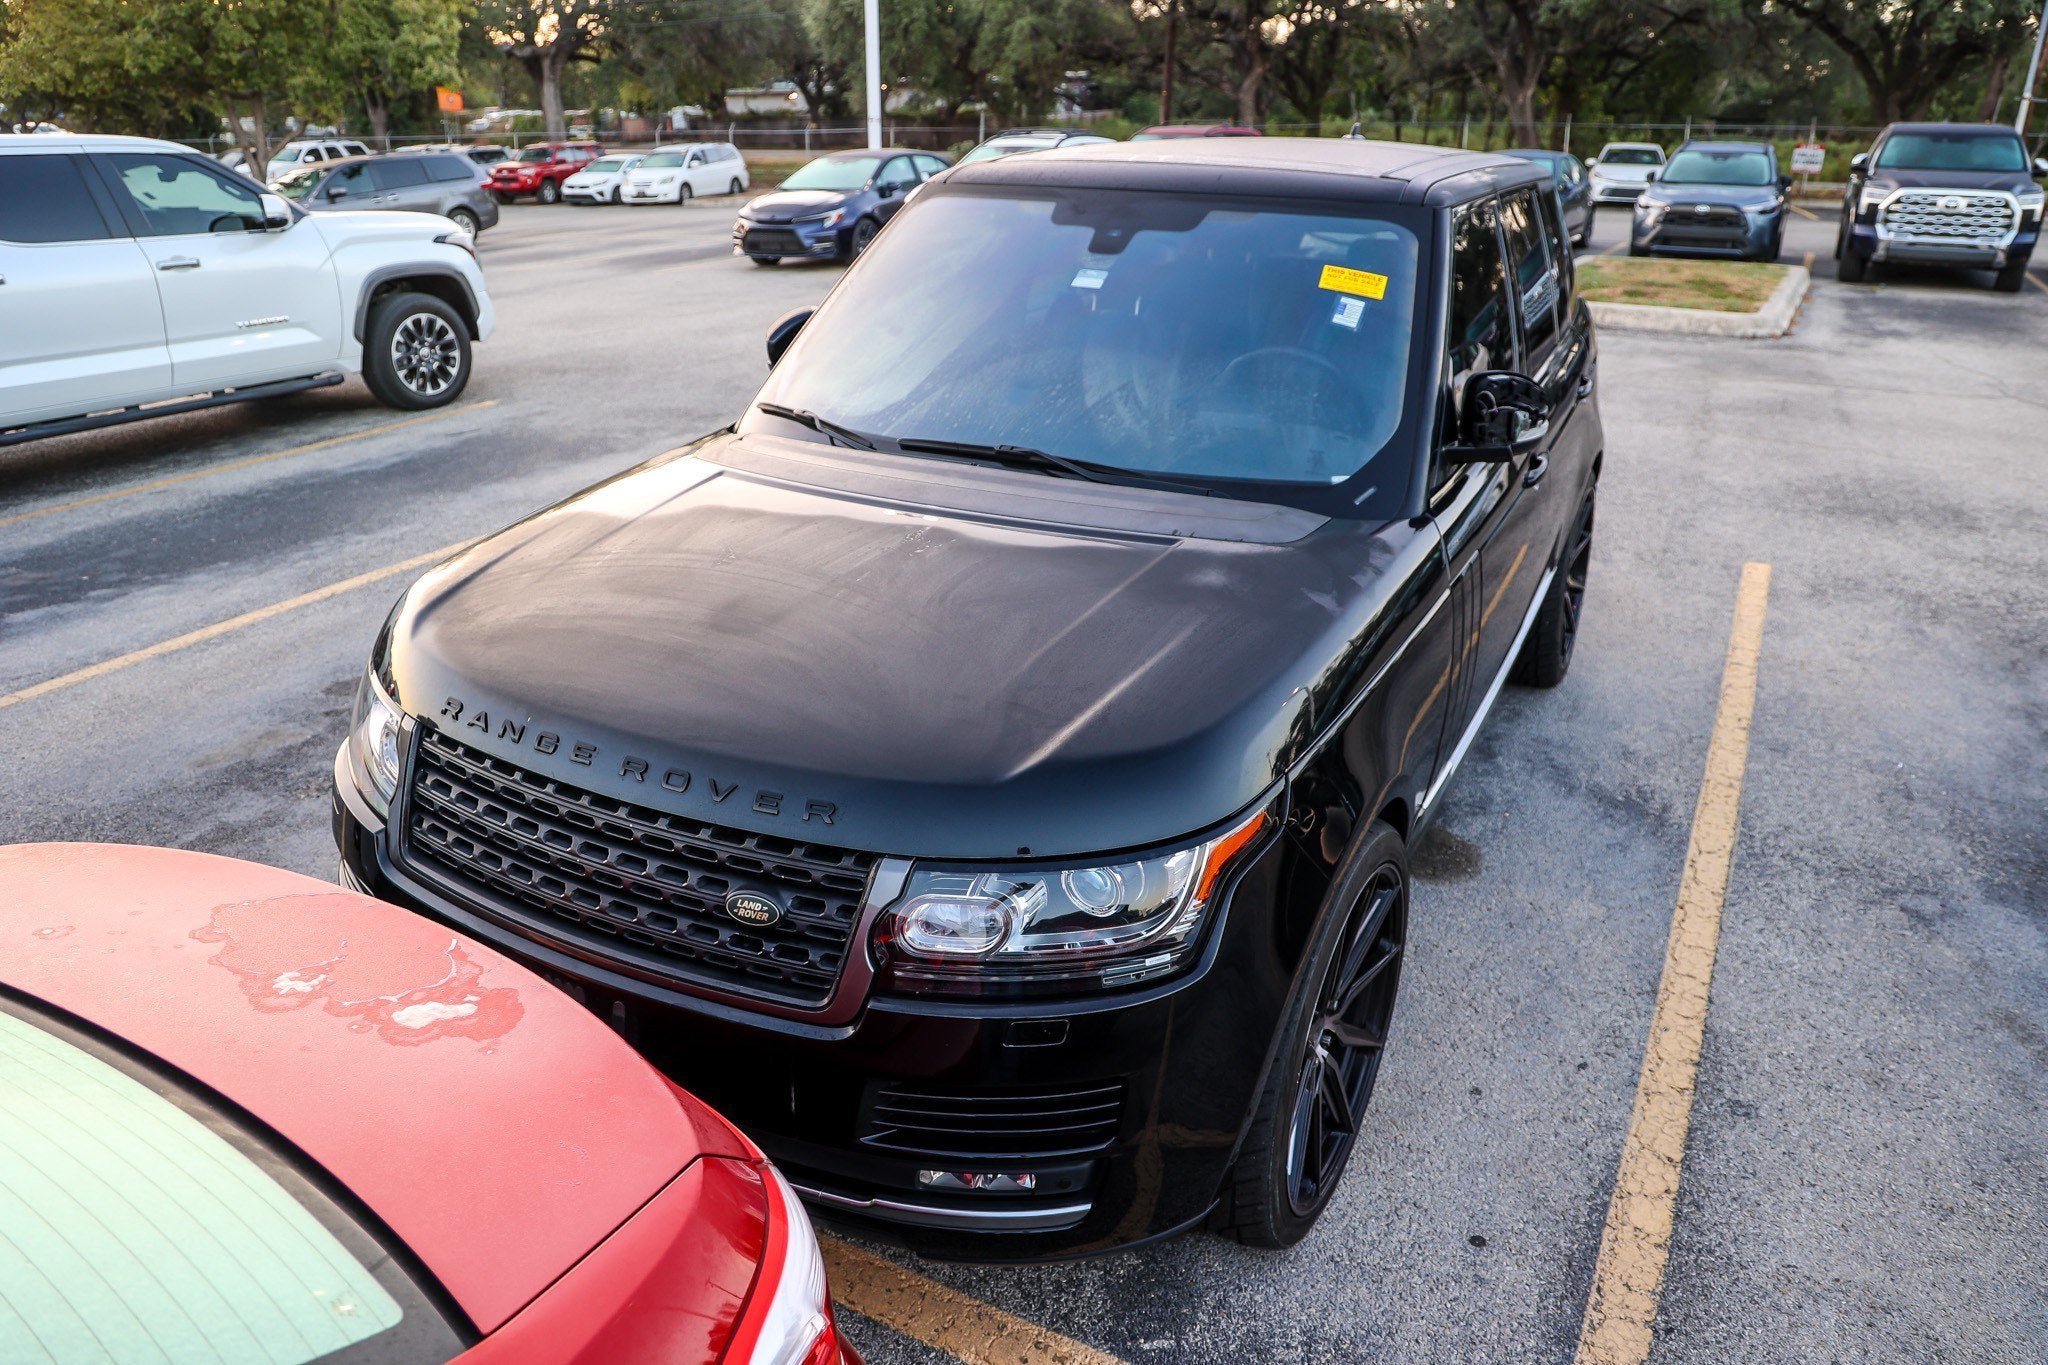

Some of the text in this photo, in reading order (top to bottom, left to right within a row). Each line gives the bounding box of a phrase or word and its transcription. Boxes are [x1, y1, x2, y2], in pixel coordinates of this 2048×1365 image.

[1327, 267, 1383, 282] THIS VEHICLE
[441, 695, 837, 825] RANGE ROVER
[736, 899, 762, 911] LAND
[737, 908, 770, 922] ROVER
